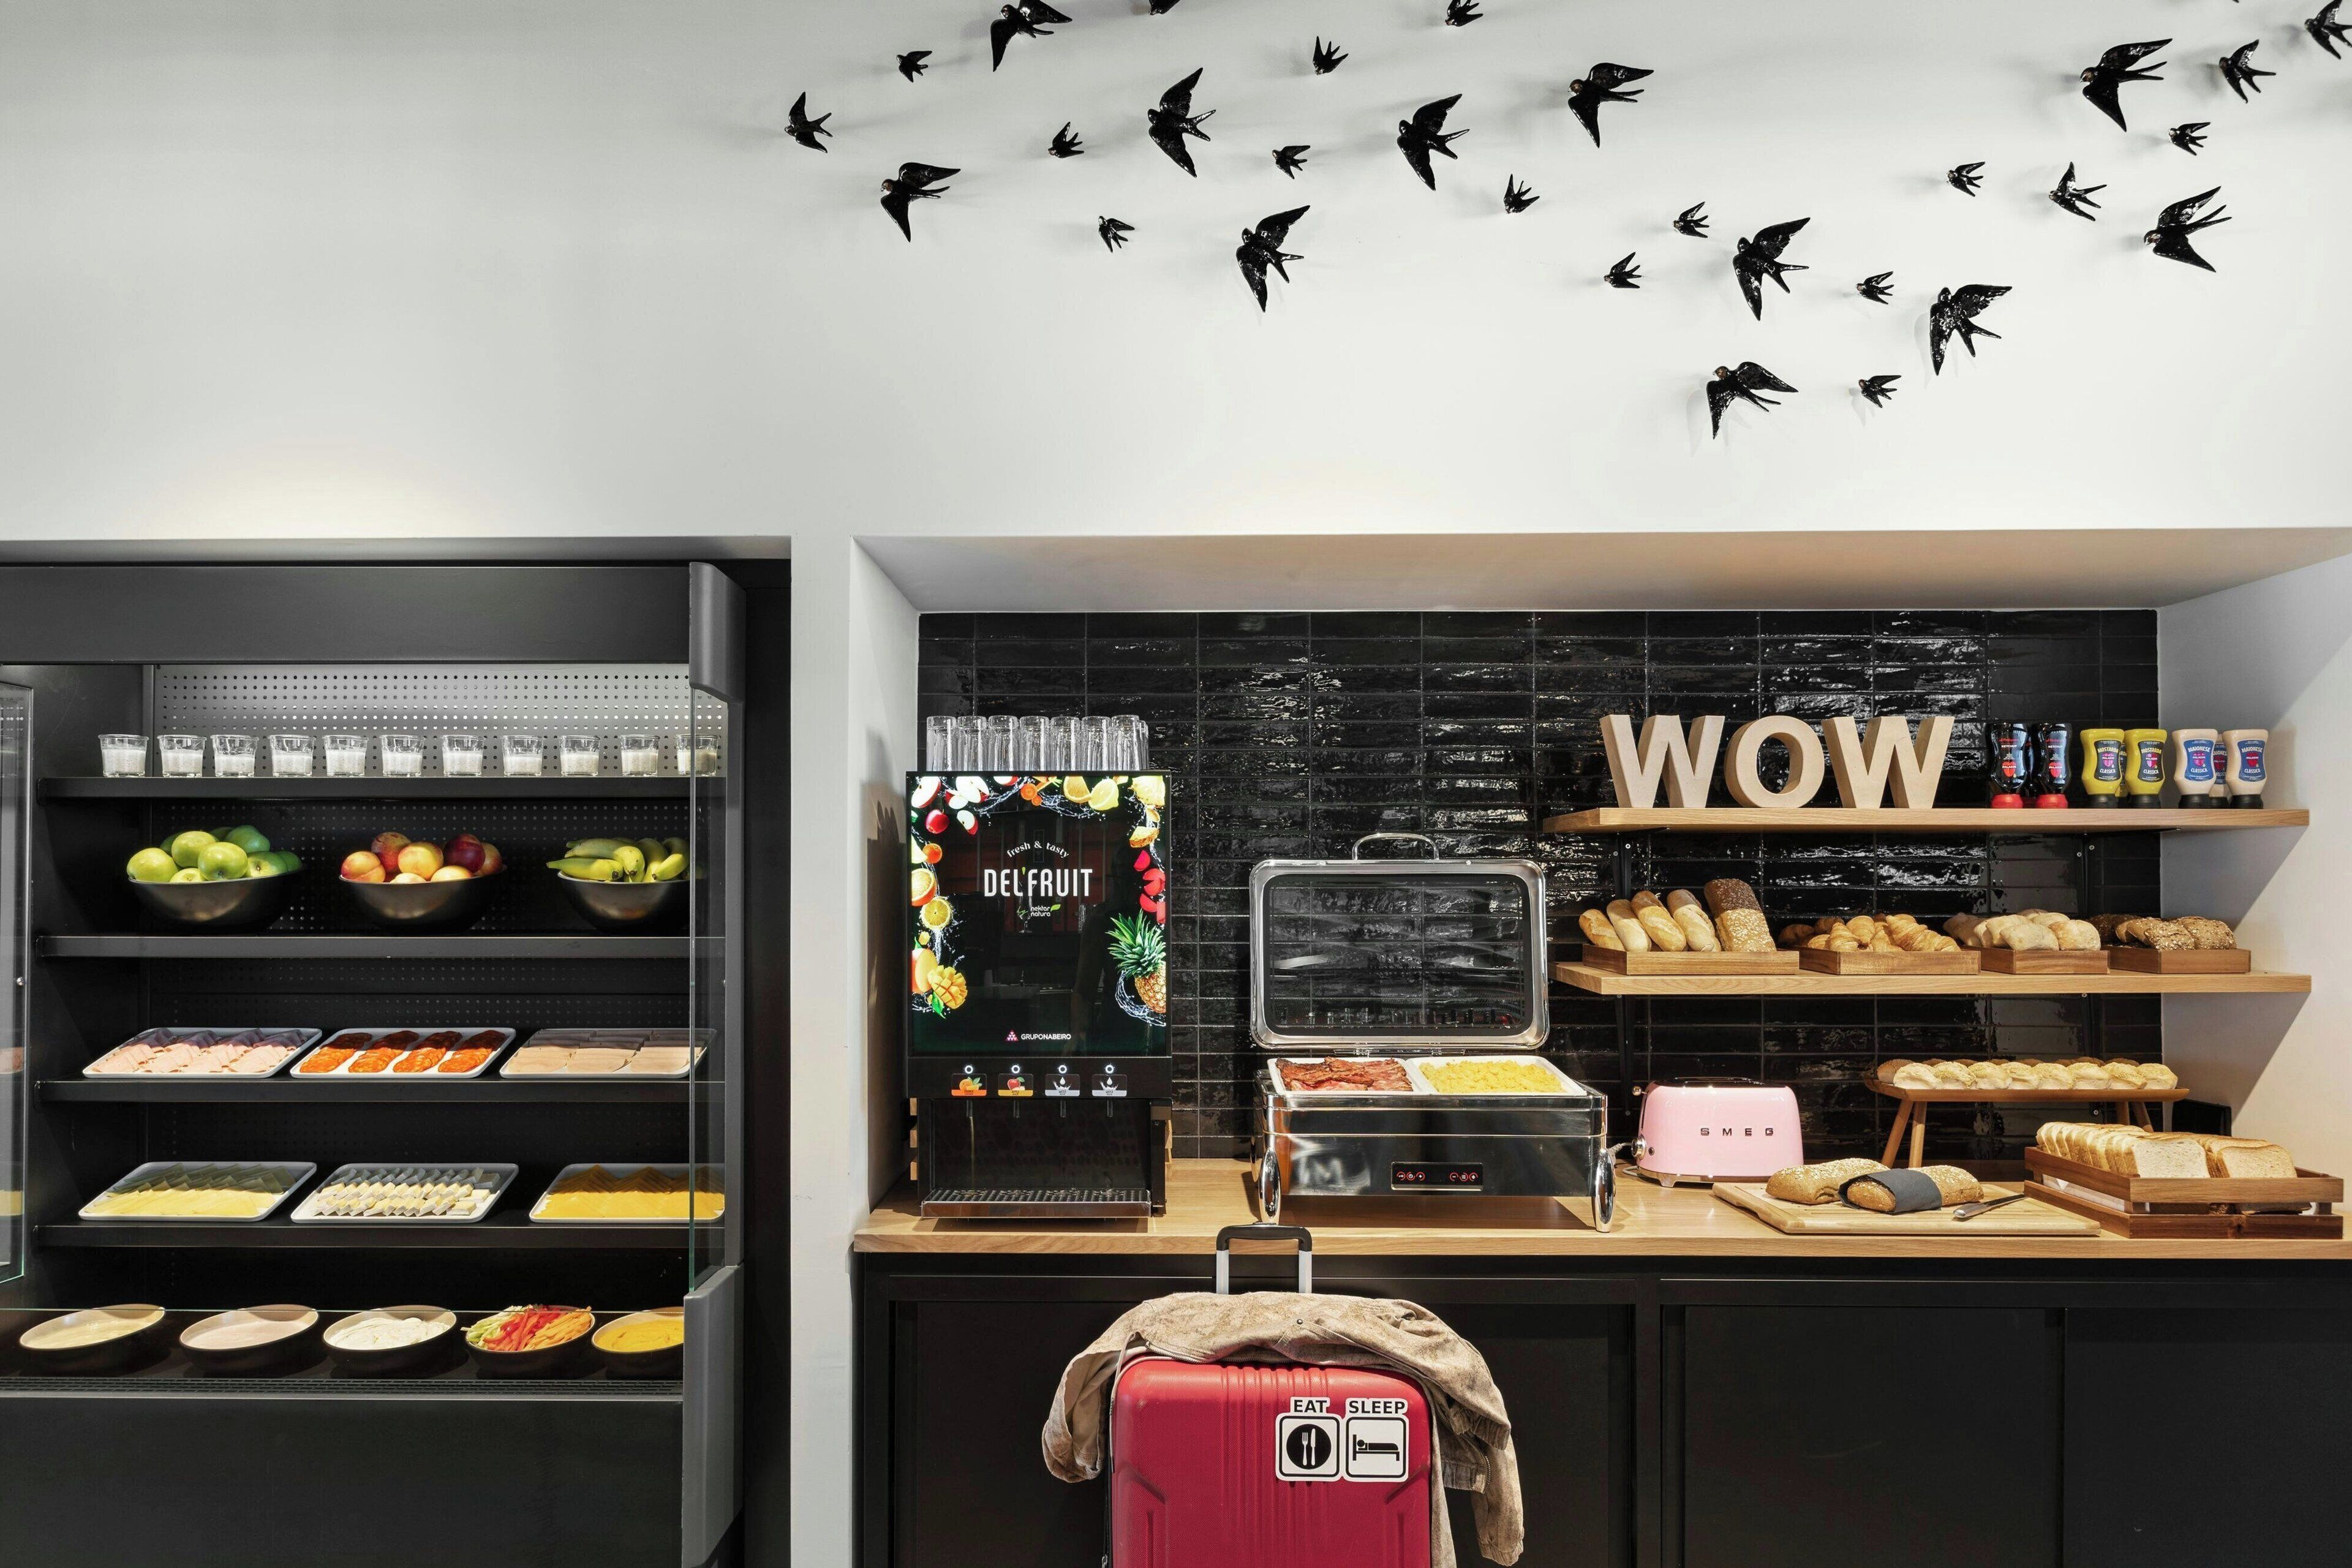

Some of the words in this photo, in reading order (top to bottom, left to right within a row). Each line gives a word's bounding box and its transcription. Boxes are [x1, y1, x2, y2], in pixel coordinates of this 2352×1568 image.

[1599, 715, 1954, 809] WOW
[1006, 842, 1031, 858] fresh
[1046, 842, 1069, 858] tasty
[984, 867, 1093, 897] DEL'FRUIT
[1700, 1128, 1774, 1136] SMEG
[1294, 1400, 1327, 1412] EAT
[1349, 1401, 1406, 1414] SLEEP
